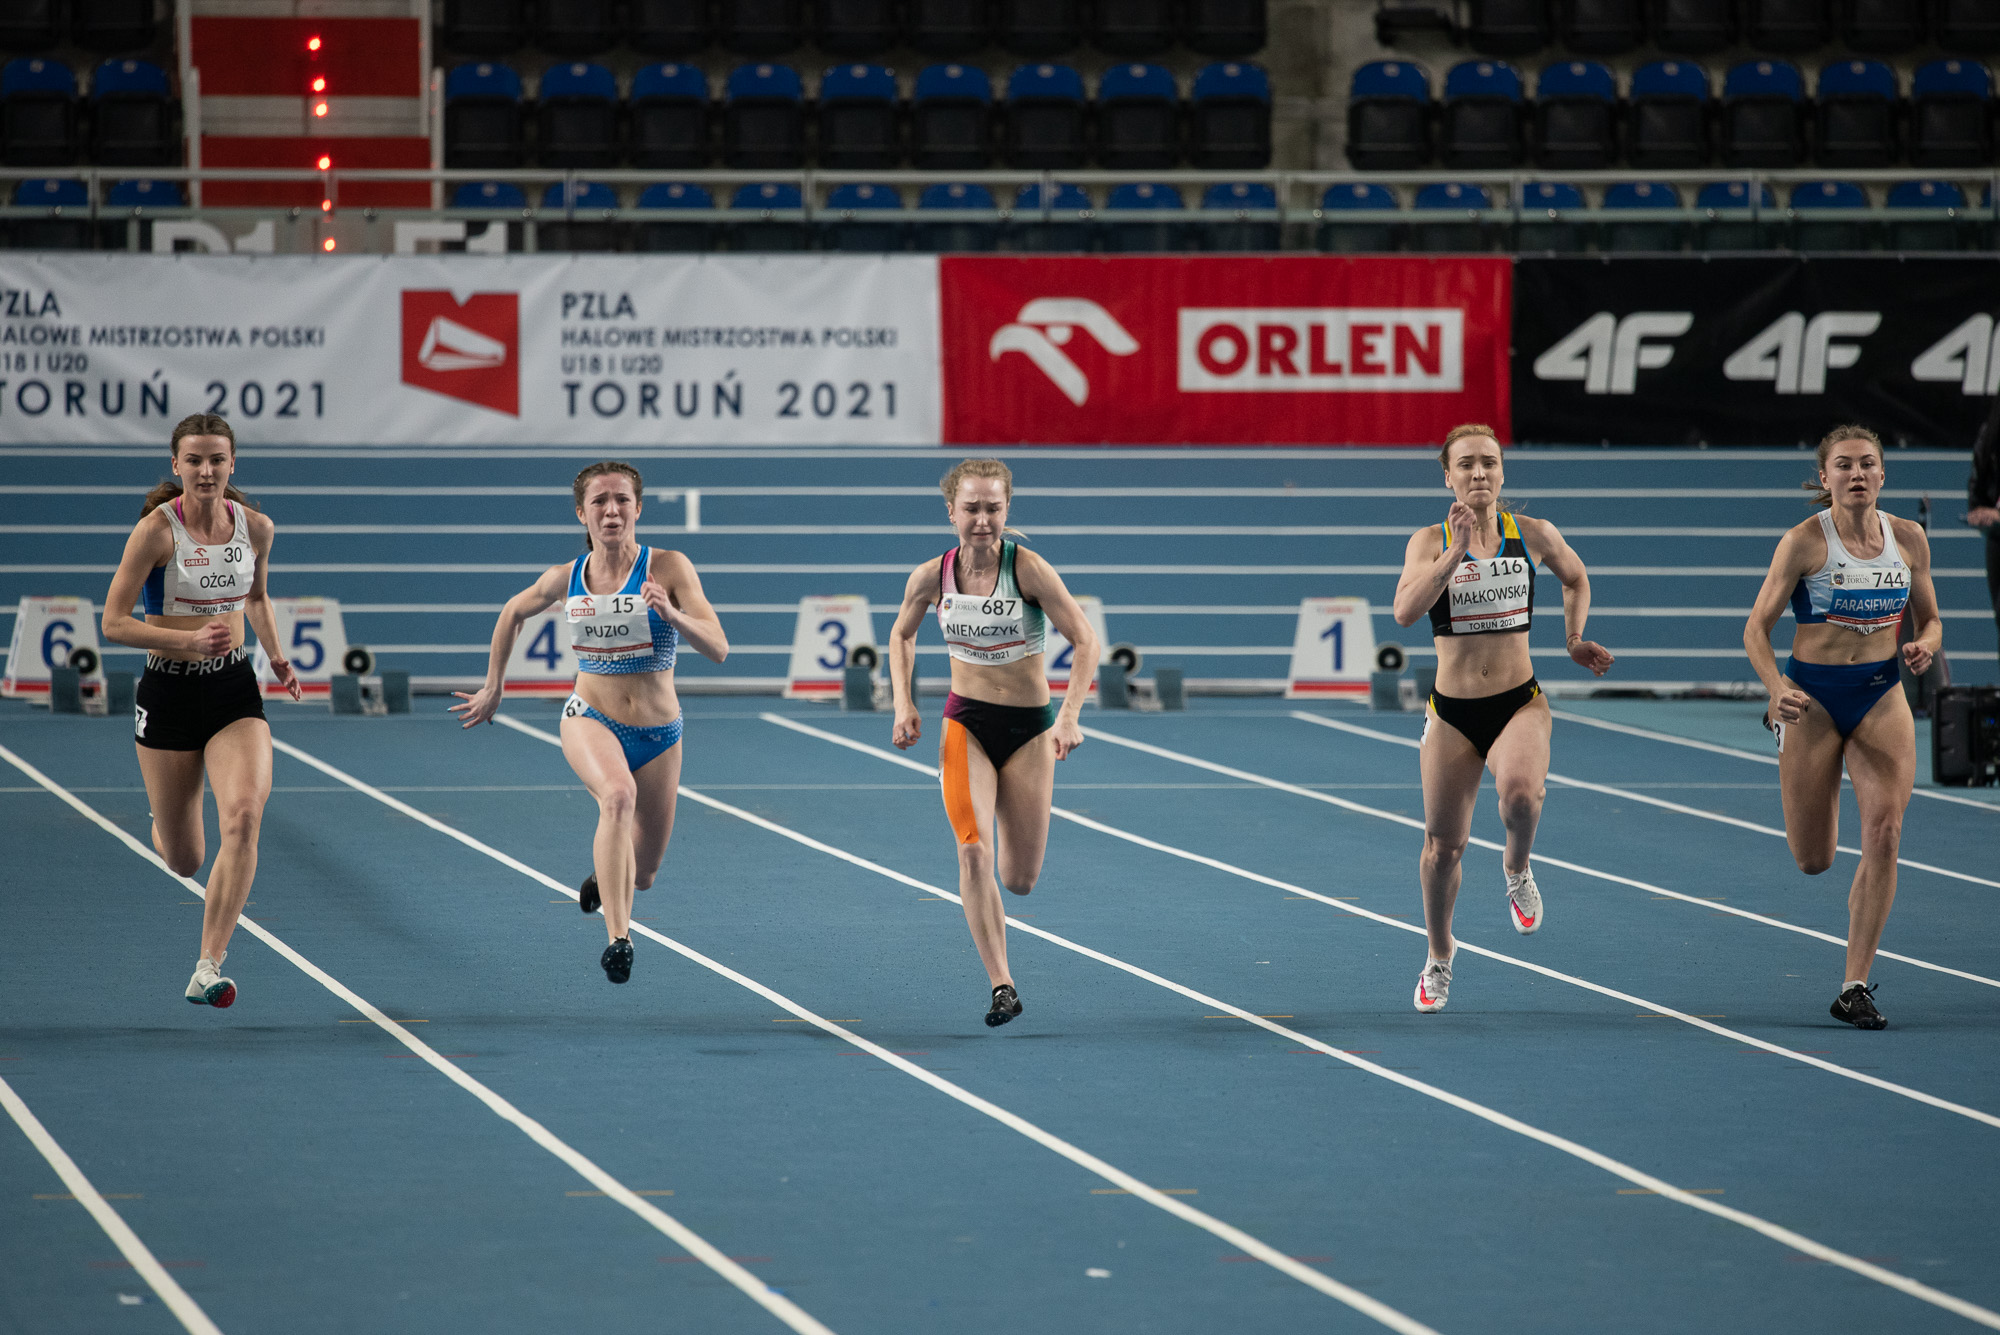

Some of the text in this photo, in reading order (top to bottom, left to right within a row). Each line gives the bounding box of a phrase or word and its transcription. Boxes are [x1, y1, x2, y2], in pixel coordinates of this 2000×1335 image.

[0, 290, 61, 317] ZLA
[561, 291, 636, 319] PZLA
[0, 325, 325, 347] ALOWE MISTRZOSTWA POLSKI
[561, 327, 897, 348] HALOWE MISTRZOSTWA POLSKI
[1196, 322, 1442, 378] ORLEN
[1533, 311, 1694, 394] 4F
[1723, 311, 1882, 394] 4F
[1911, 312, 2000, 395] 4
[0, 352, 88, 373] 18 I U20
[561, 354, 663, 375] U18 I U20
[205, 380, 325, 418] 2021
[562, 368, 897, 418] TORUŃ 2021
[224, 547, 242, 563] 30
[1456, 574, 1480, 583] ORLEN
[1490, 560, 1522, 577] 116
[200, 572, 236, 588] OŻGA
[1872, 572, 1904, 587] 744
[612, 597, 634, 613] 15
[1452, 584, 1527, 606] MAŁKOWSKA
[1834, 598, 1907, 612] FARASIEWICZ
[191, 604, 235, 614] TORUŃ 2021
[572, 608, 595, 616] ORLEN
[982, 600, 1016, 616] 687
[585, 624, 629, 638] PUZIO
[946, 623, 1019, 638] NIEMCZYK
[1469, 618, 1516, 630] TORUŃ 2021
[42, 620, 74, 668] 6
[291, 621, 325, 671] 5
[526, 620, 562, 670] 4
[818, 620, 847, 669] 3
[963, 648, 1010, 660] TORUŃ 2021
[1321, 620, 1343, 671] 1
[147, 651, 183, 675] NIKE
[185, 656, 224, 675] PRO
[588, 652, 636, 662] TORUŃ 2021
